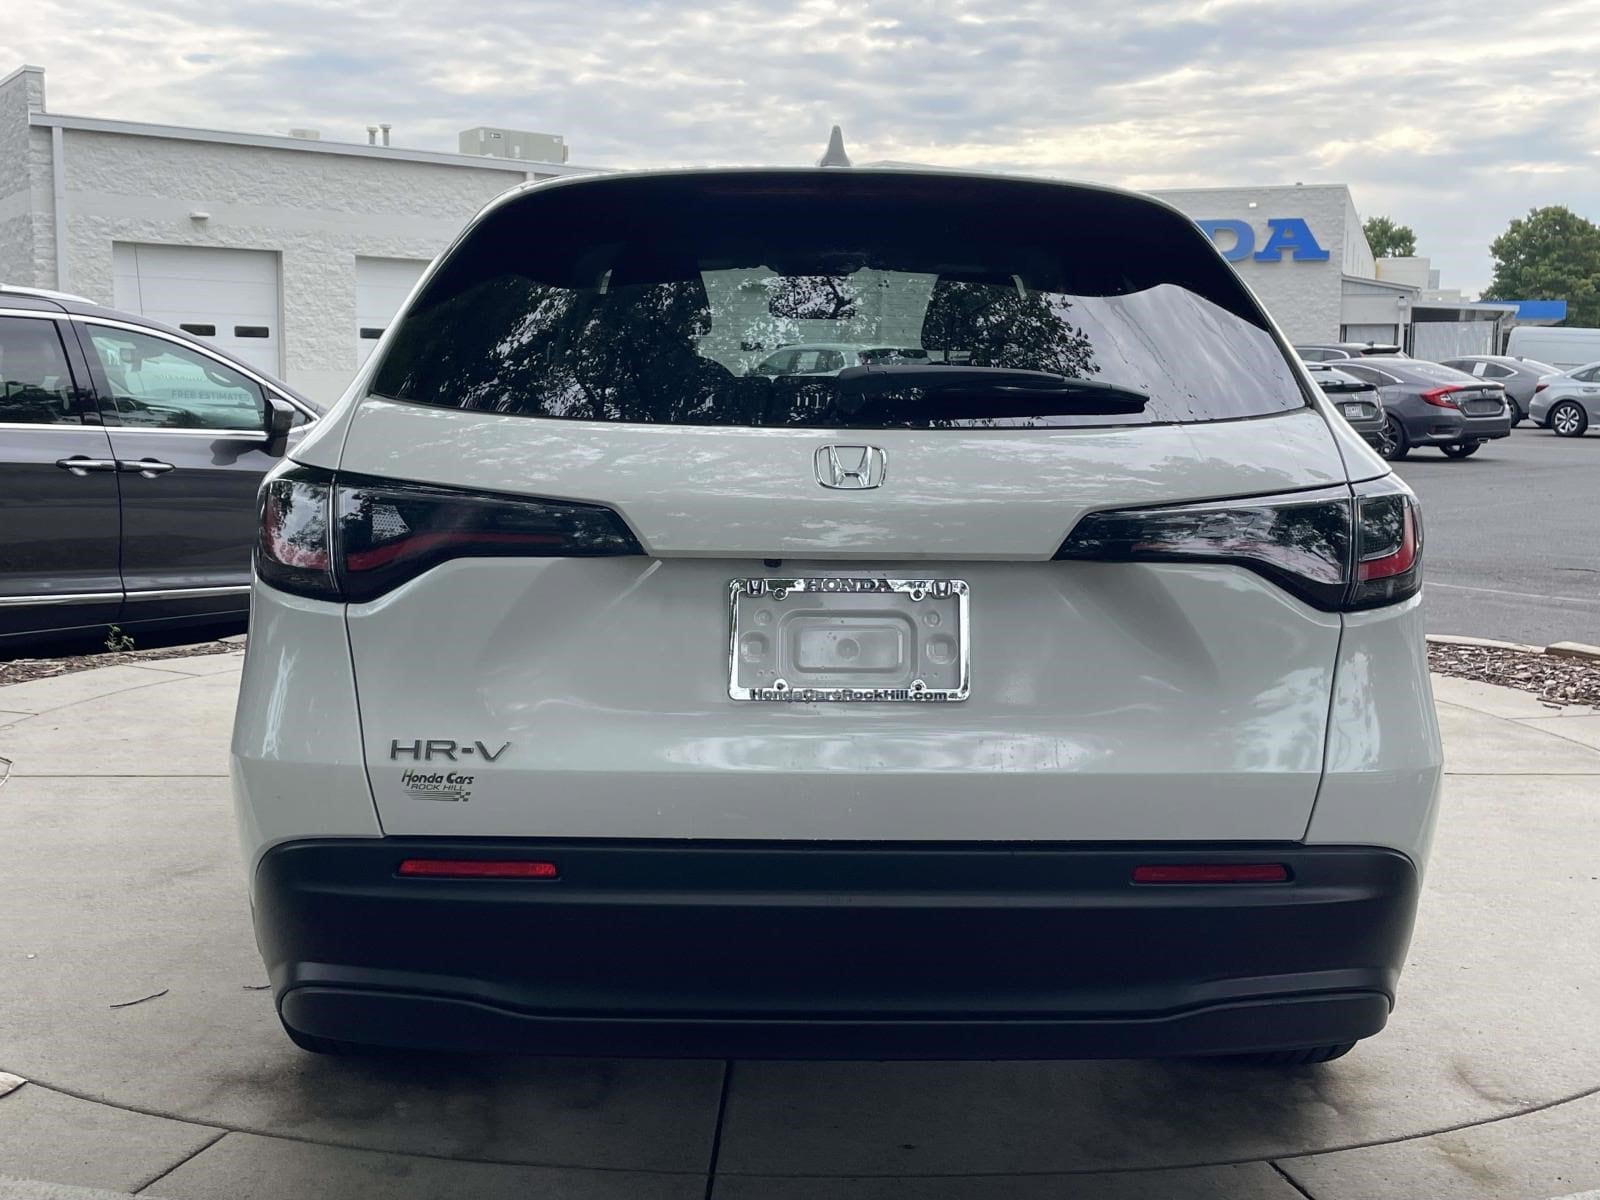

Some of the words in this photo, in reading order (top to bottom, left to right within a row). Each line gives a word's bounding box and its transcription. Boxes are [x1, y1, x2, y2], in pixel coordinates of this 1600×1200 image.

[171, 390, 196, 400] FREE
[803, 578, 895, 592] HONDA
[750, 688, 948, 701] HondaCarsRockHill.com
[390, 739, 511, 762] HR-V
[401, 769, 444, 786] Honda
[446, 771, 474, 785] Cars
[410, 783, 441, 791] ROCK
[442, 784, 466, 792] HILL
